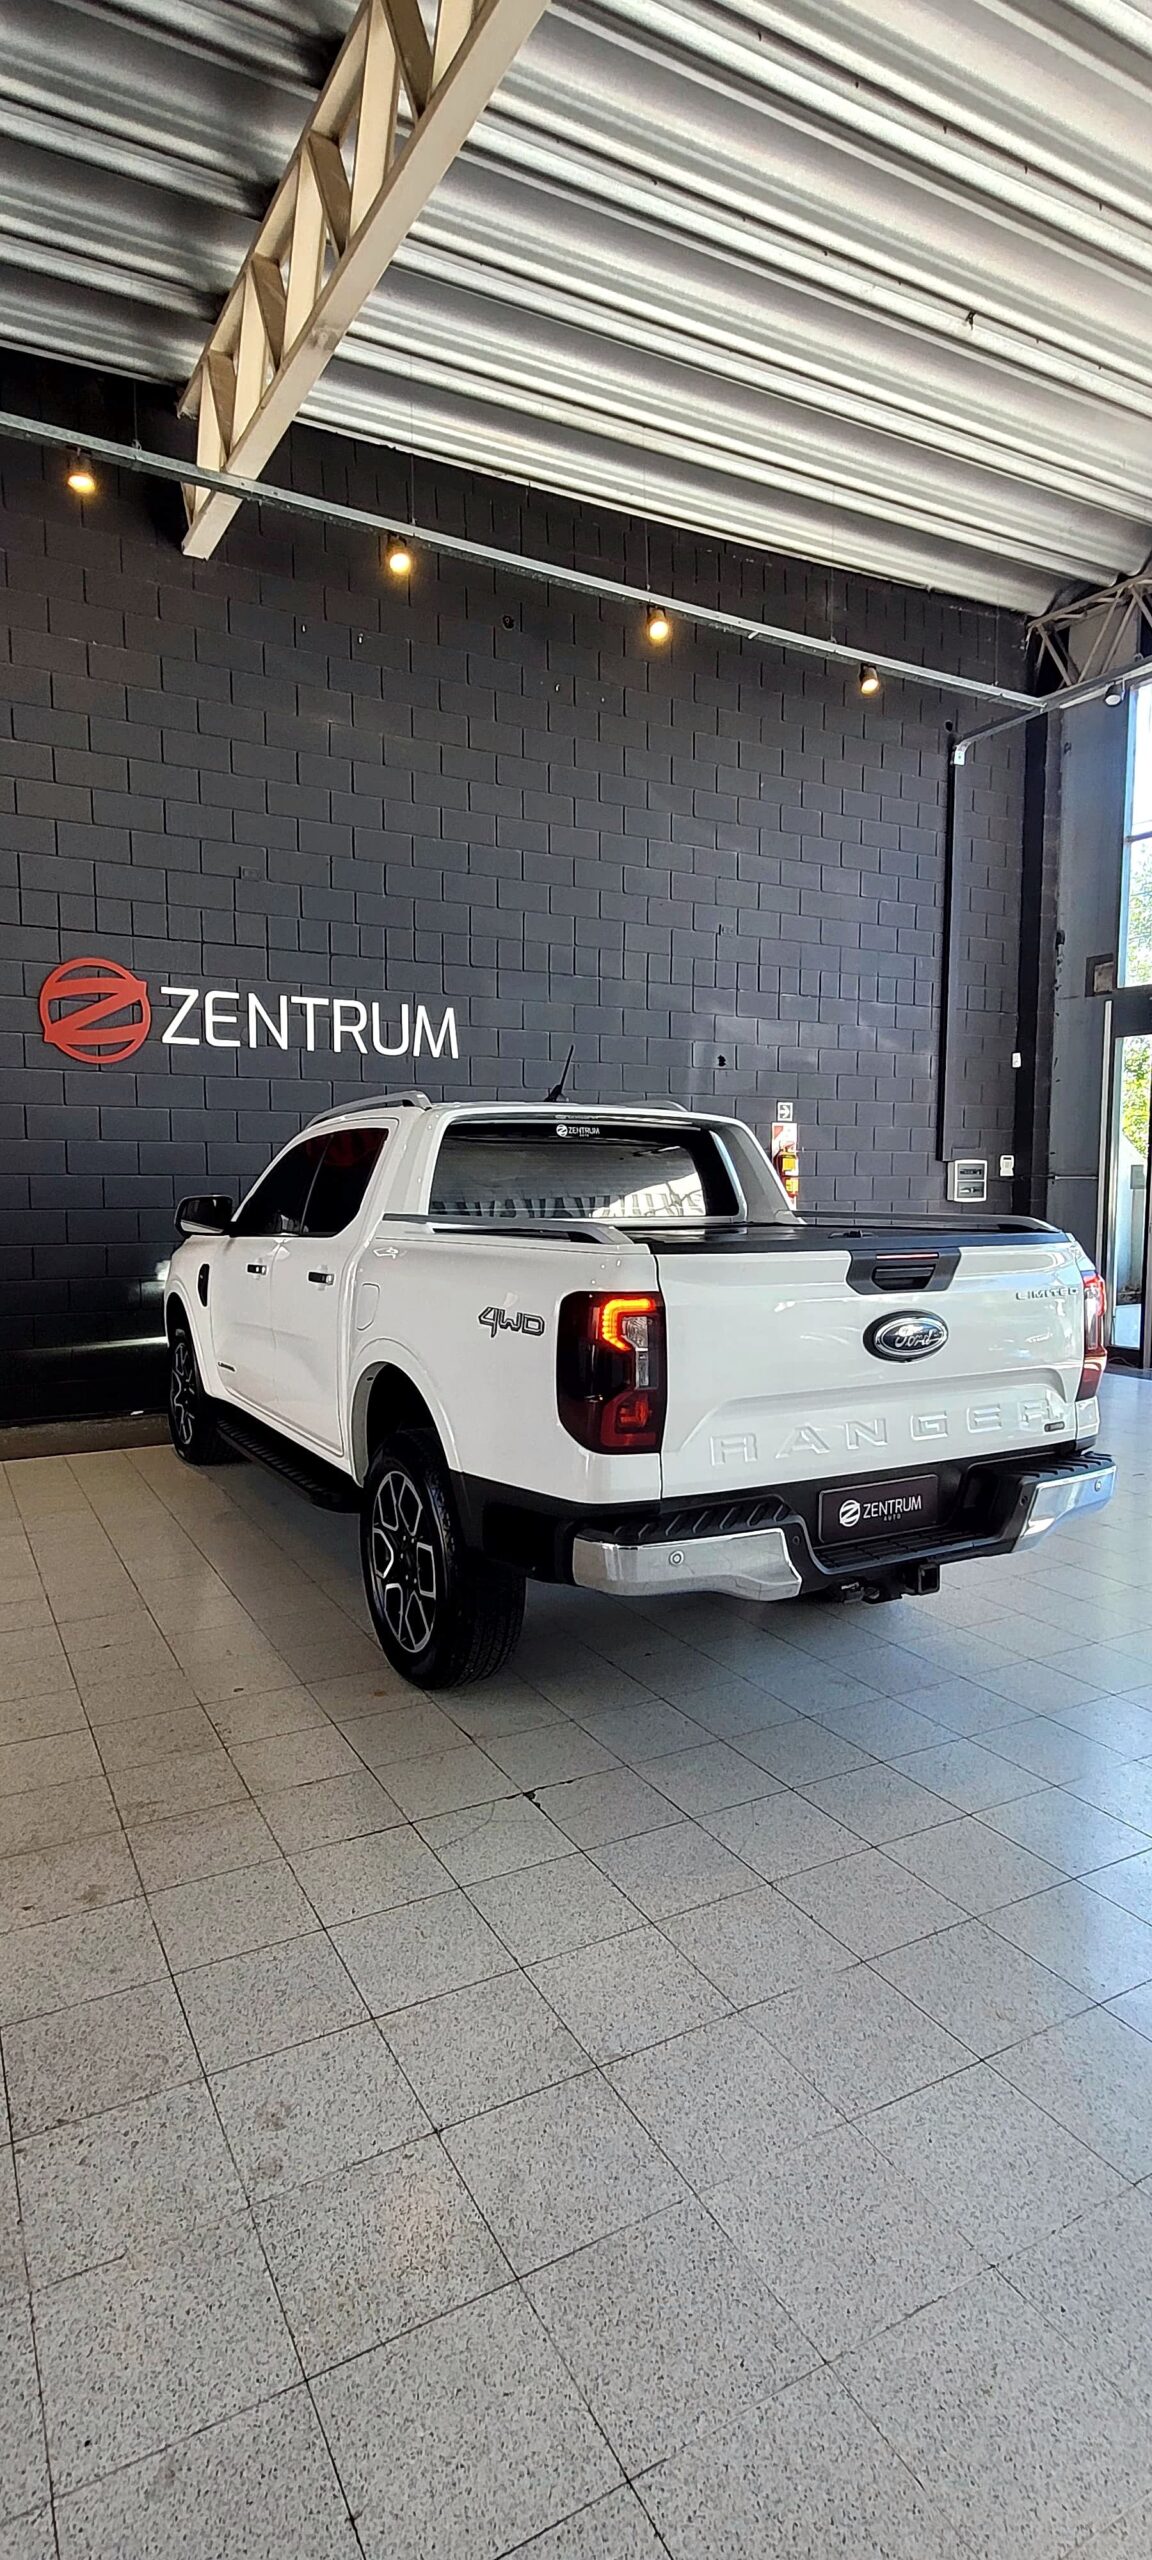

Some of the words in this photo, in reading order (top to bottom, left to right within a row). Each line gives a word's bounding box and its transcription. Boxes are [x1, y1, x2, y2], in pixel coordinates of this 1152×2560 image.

[160, 986, 459, 1060] ZENTRUM
[1016, 1287, 1079, 1300] LIMITED
[478, 1306, 545, 1338] 4WD
[894, 1325, 940, 1348] Ford
[710, 1399, 1050, 1466] RANGER
[862, 1495, 922, 1519] ZENTRUM
[883, 1513, 902, 1521] AUTO
